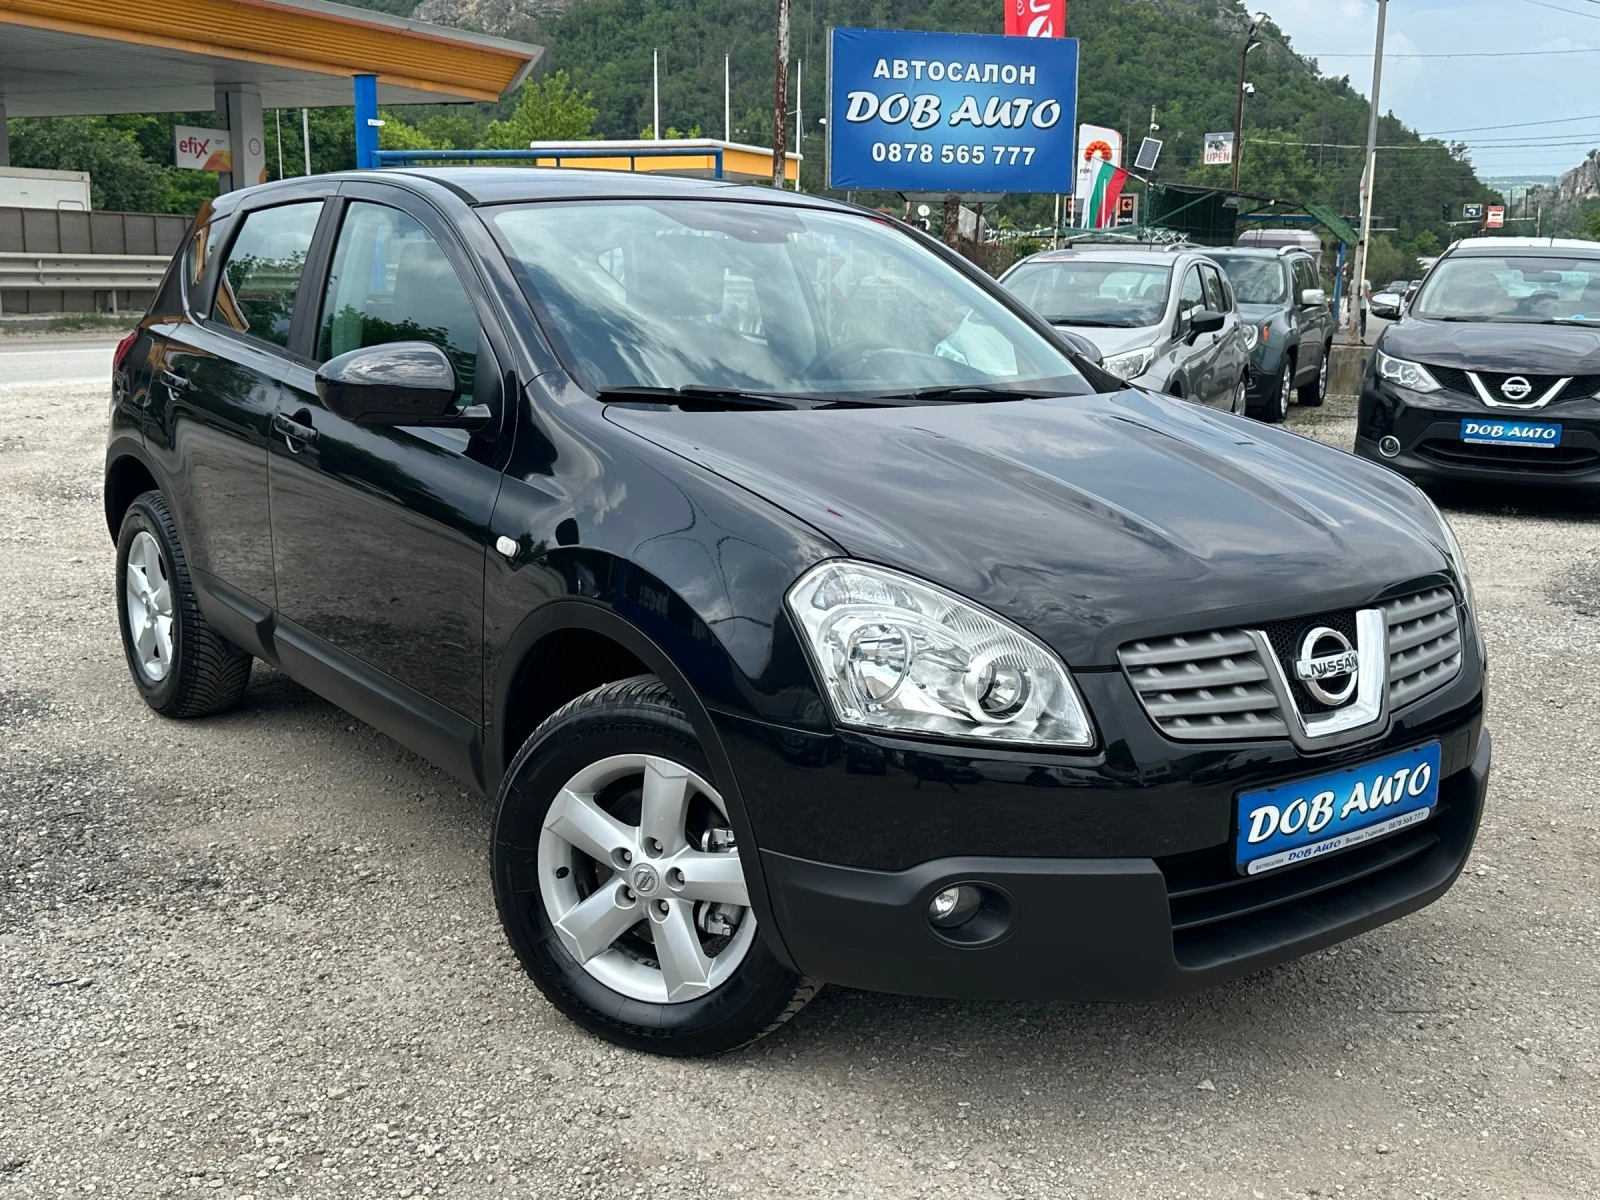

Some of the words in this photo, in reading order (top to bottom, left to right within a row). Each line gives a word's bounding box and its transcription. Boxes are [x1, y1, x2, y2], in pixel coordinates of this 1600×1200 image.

[873, 59, 1037, 85] АВТОСАЛОН
[845, 91, 941, 129] DOB
[949, 96, 1062, 128] AUTO
[179, 136, 210, 158] efix
[872, 143, 933, 164] 0878
[941, 145, 985, 165] 565
[992, 147, 1036, 166] 777
[1465, 423, 1504, 437] DOB
[1507, 426, 1556, 439] AUTO
[1310, 654, 1358, 676] NISSAN
[1247, 791, 1335, 843] DOB
[1340, 762, 1431, 819] AUTO
[1288, 848, 1312, 861] DOB
